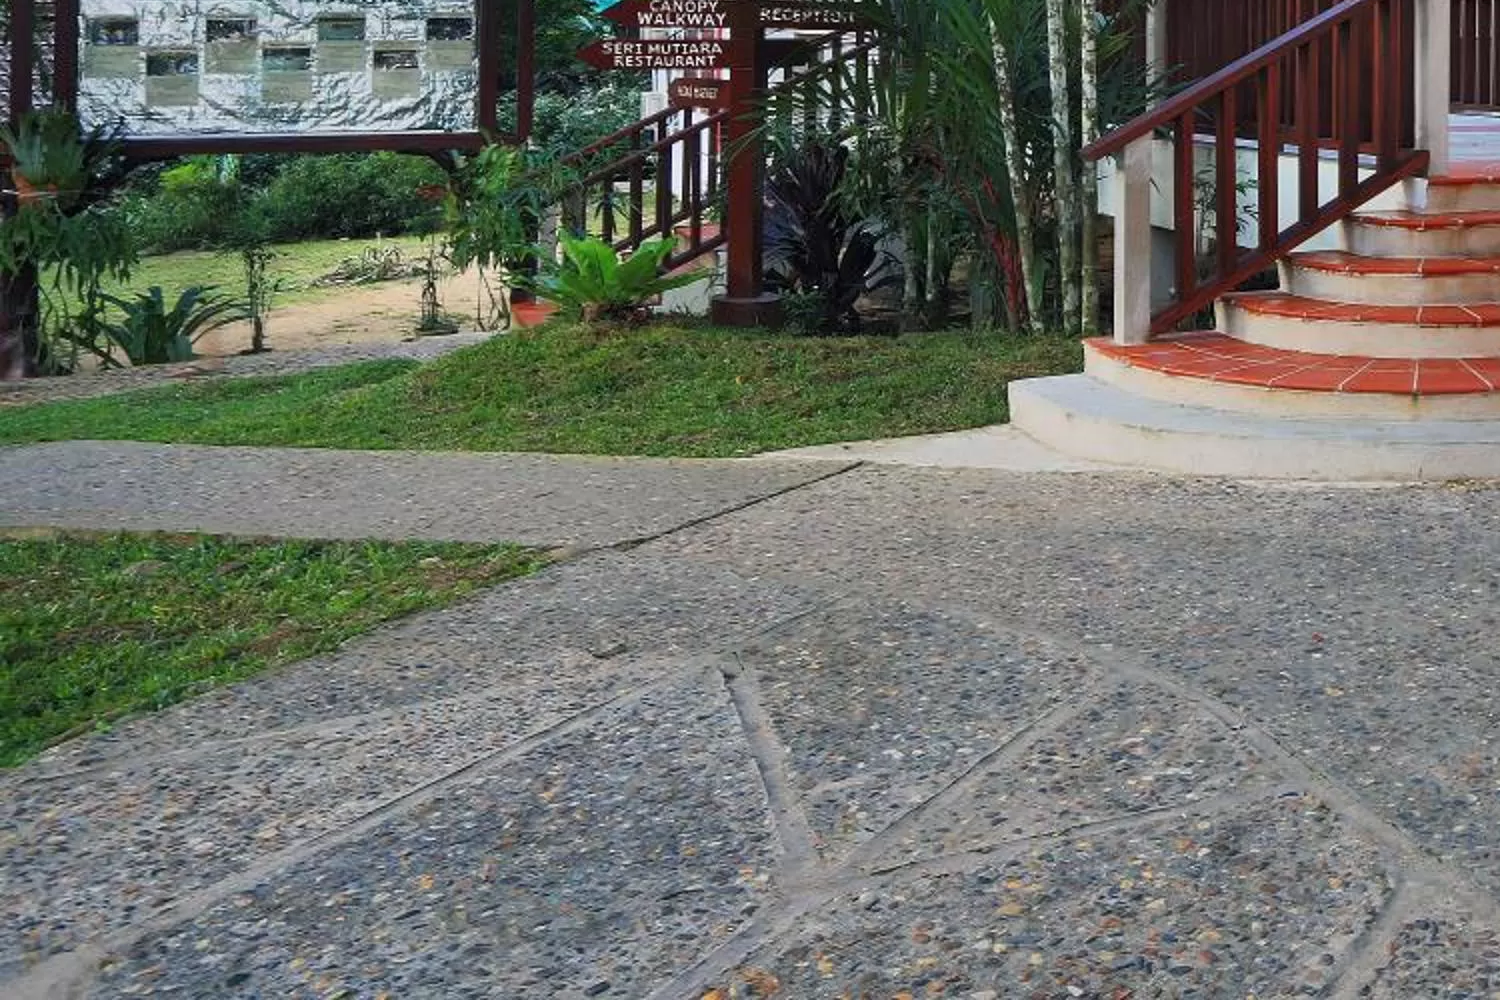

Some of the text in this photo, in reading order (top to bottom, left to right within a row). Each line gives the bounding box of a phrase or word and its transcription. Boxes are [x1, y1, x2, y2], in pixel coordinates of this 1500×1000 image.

[649, 0, 719, 13] CANOPY
[638, 12, 727, 26] WALKWAY
[760, 7, 857, 23] RECEPTION
[602, 42, 723, 55] SERI MUTIARA
[614, 55, 716, 67] RESTAURANT
